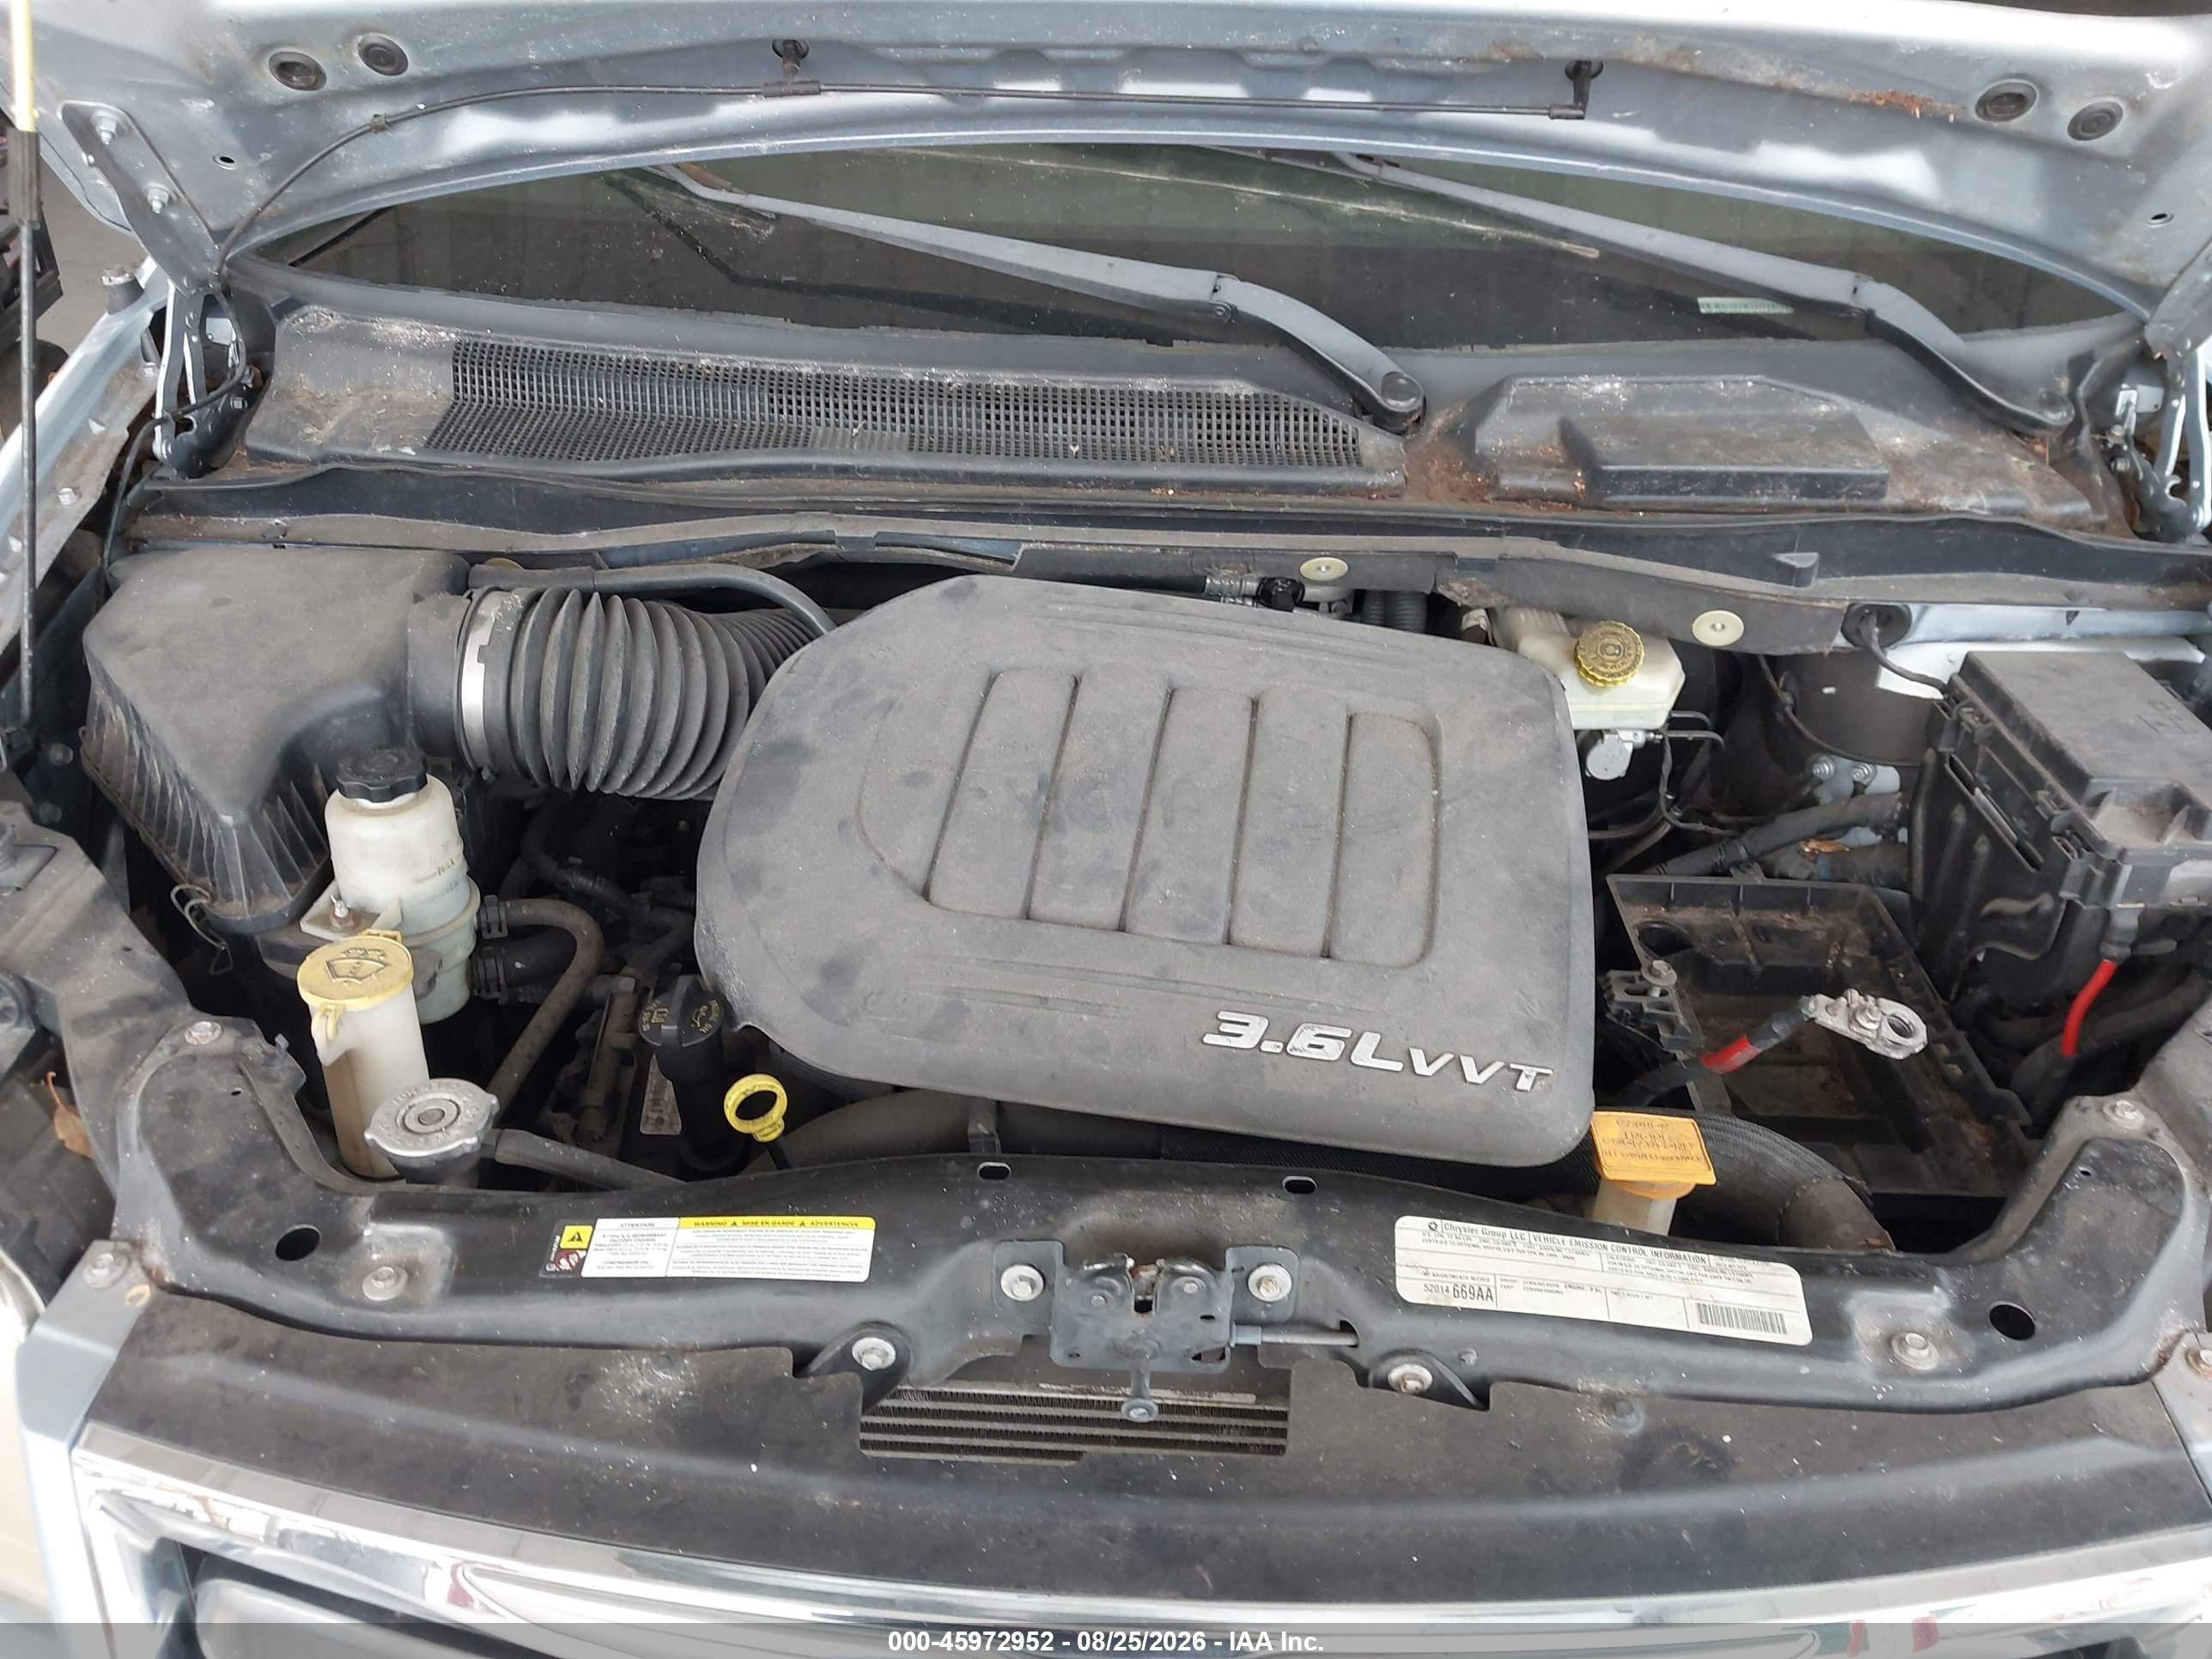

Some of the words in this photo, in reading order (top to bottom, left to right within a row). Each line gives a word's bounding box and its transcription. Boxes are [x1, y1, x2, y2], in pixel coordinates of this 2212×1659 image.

[1202, 1010, 1404, 1072] 3.6L
[1408, 1046, 1554, 1092] VVT
[1443, 1221, 1478, 1235] Chrysler
[1481, 1228, 1507, 1241] Group
[1510, 1230, 1527, 1241] LLC
[1532, 1233, 1565, 1246] VEHICLE
[1569, 1238, 1608, 1251] EMISSION
[1611, 1244, 1649, 1257] CONTROL
[1650, 1248, 1706, 1265] INFORMATION
[1452, 1283, 1494, 1302] 669AA
